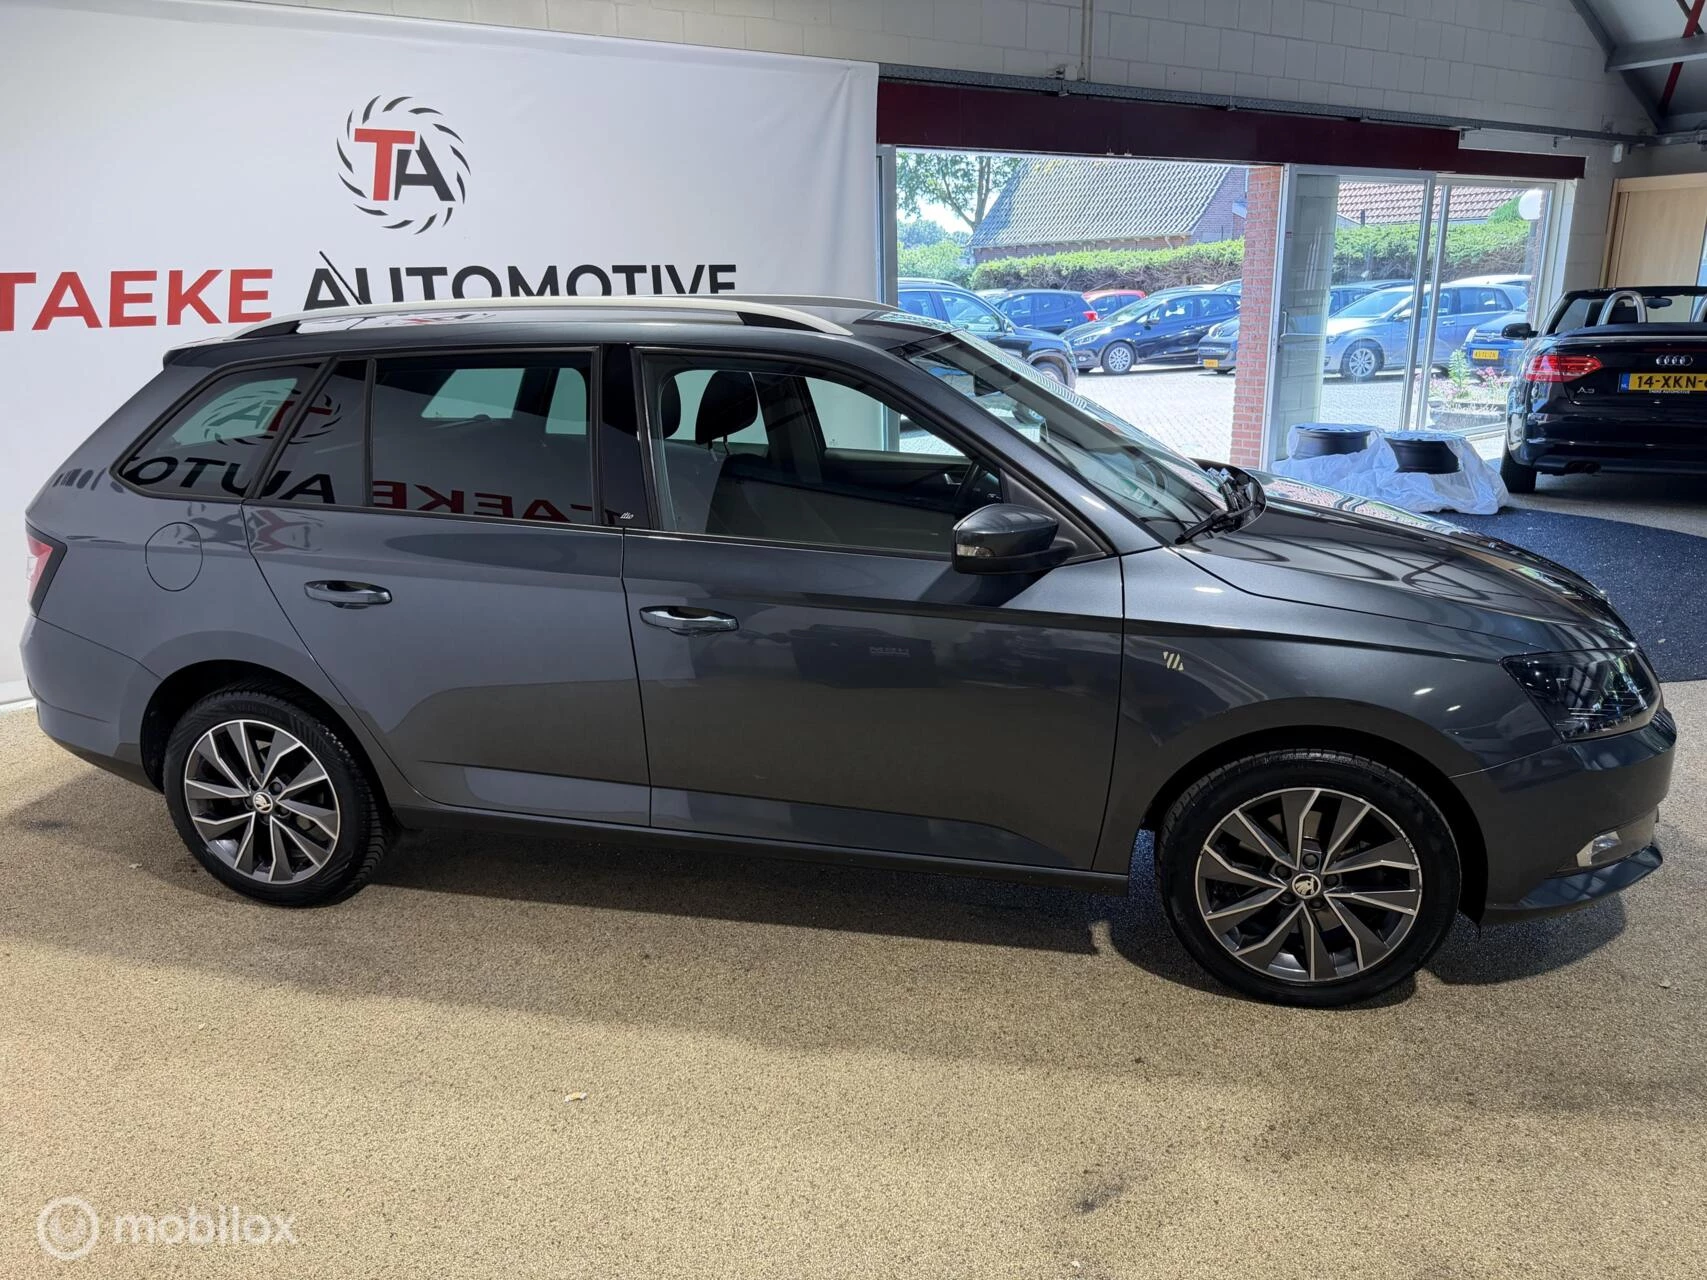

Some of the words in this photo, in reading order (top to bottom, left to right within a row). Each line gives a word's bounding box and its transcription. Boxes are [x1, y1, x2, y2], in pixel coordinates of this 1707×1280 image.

[354, 128, 456, 201] TA
[0, 268, 273, 331] TAEKE
[1576, 386, 1595, 394] A3
